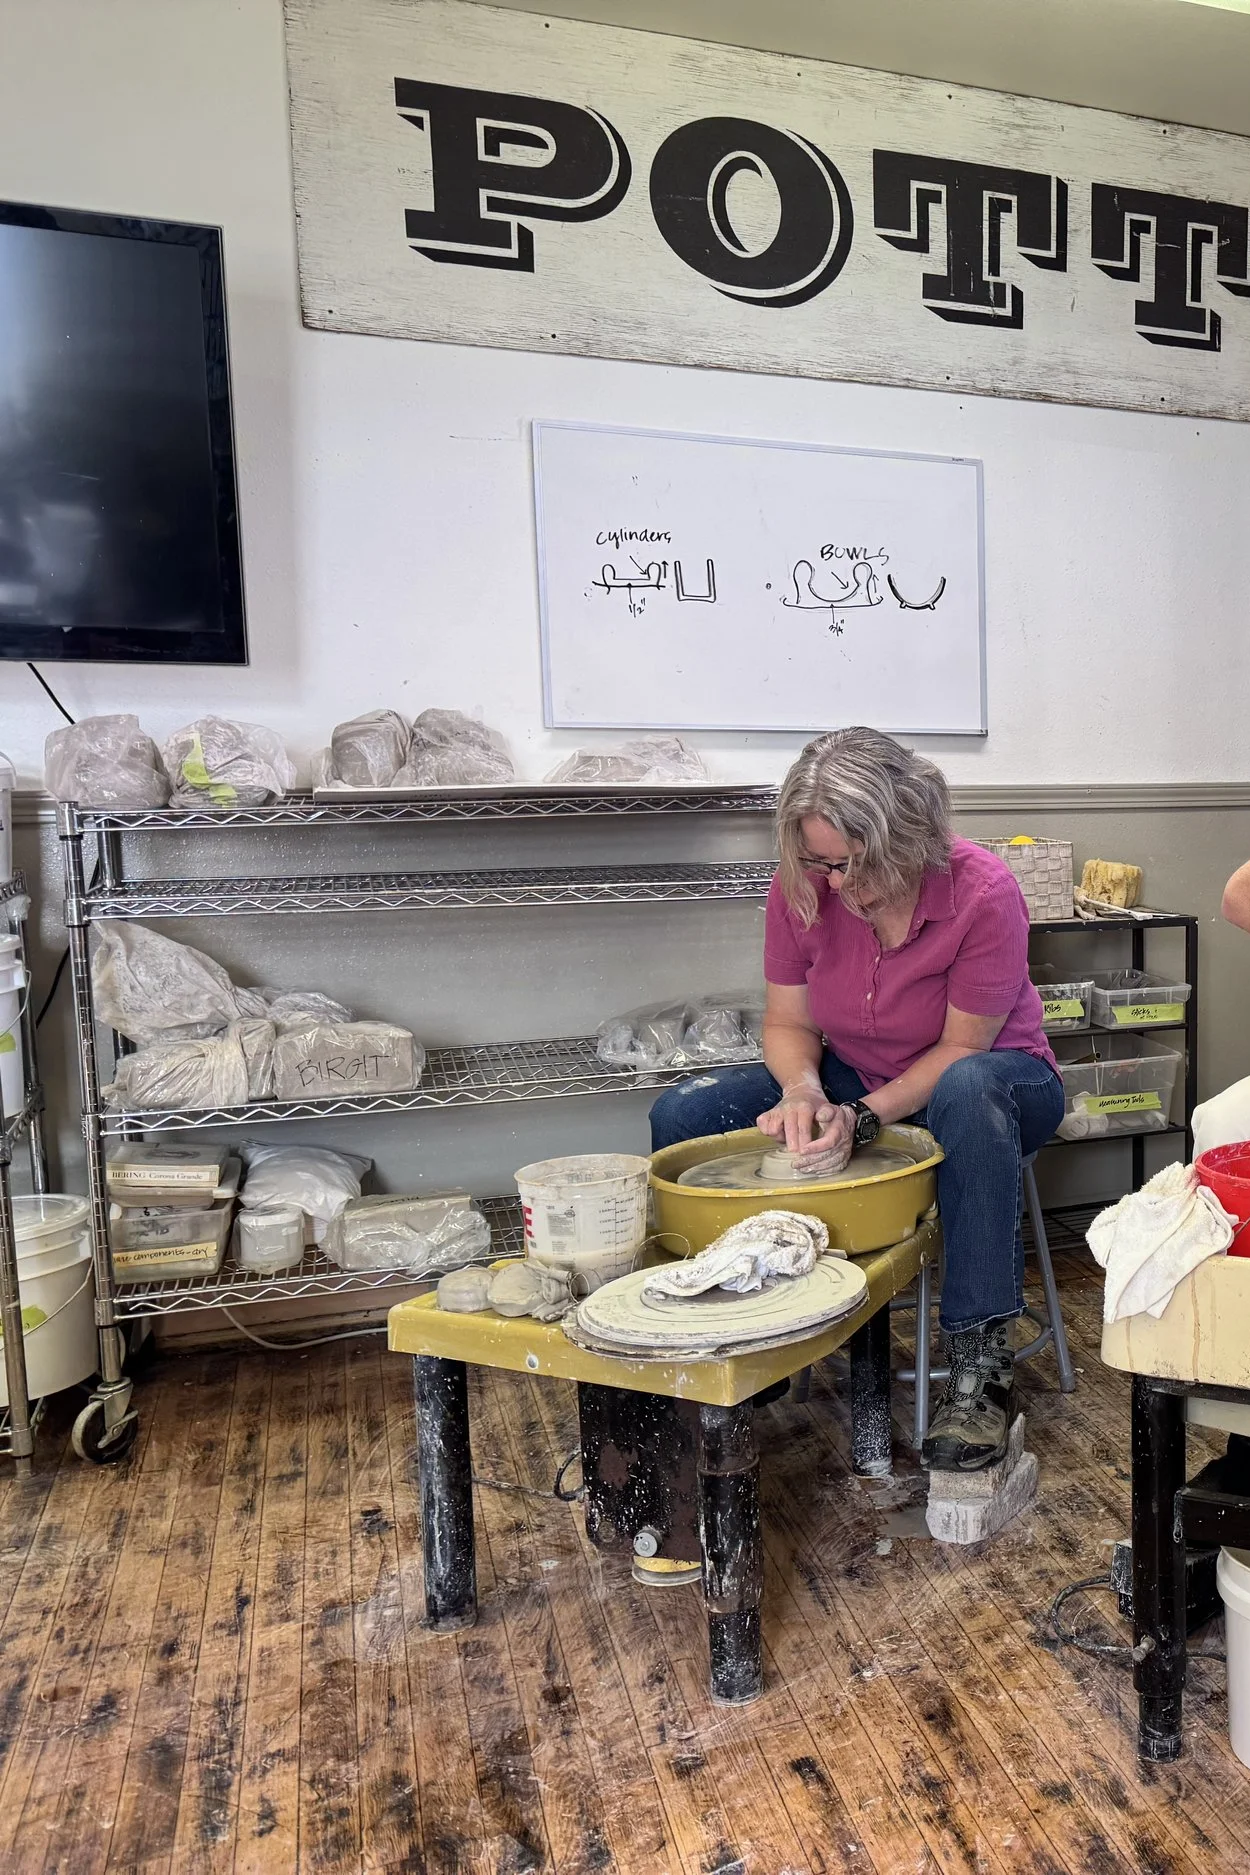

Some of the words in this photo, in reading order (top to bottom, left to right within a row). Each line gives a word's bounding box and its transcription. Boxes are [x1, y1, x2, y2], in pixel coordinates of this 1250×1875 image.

[820, 544, 889, 566] BOWLS
[295, 1055, 391, 1087] BIRGIT
[112, 1171, 146, 1179] BERING
